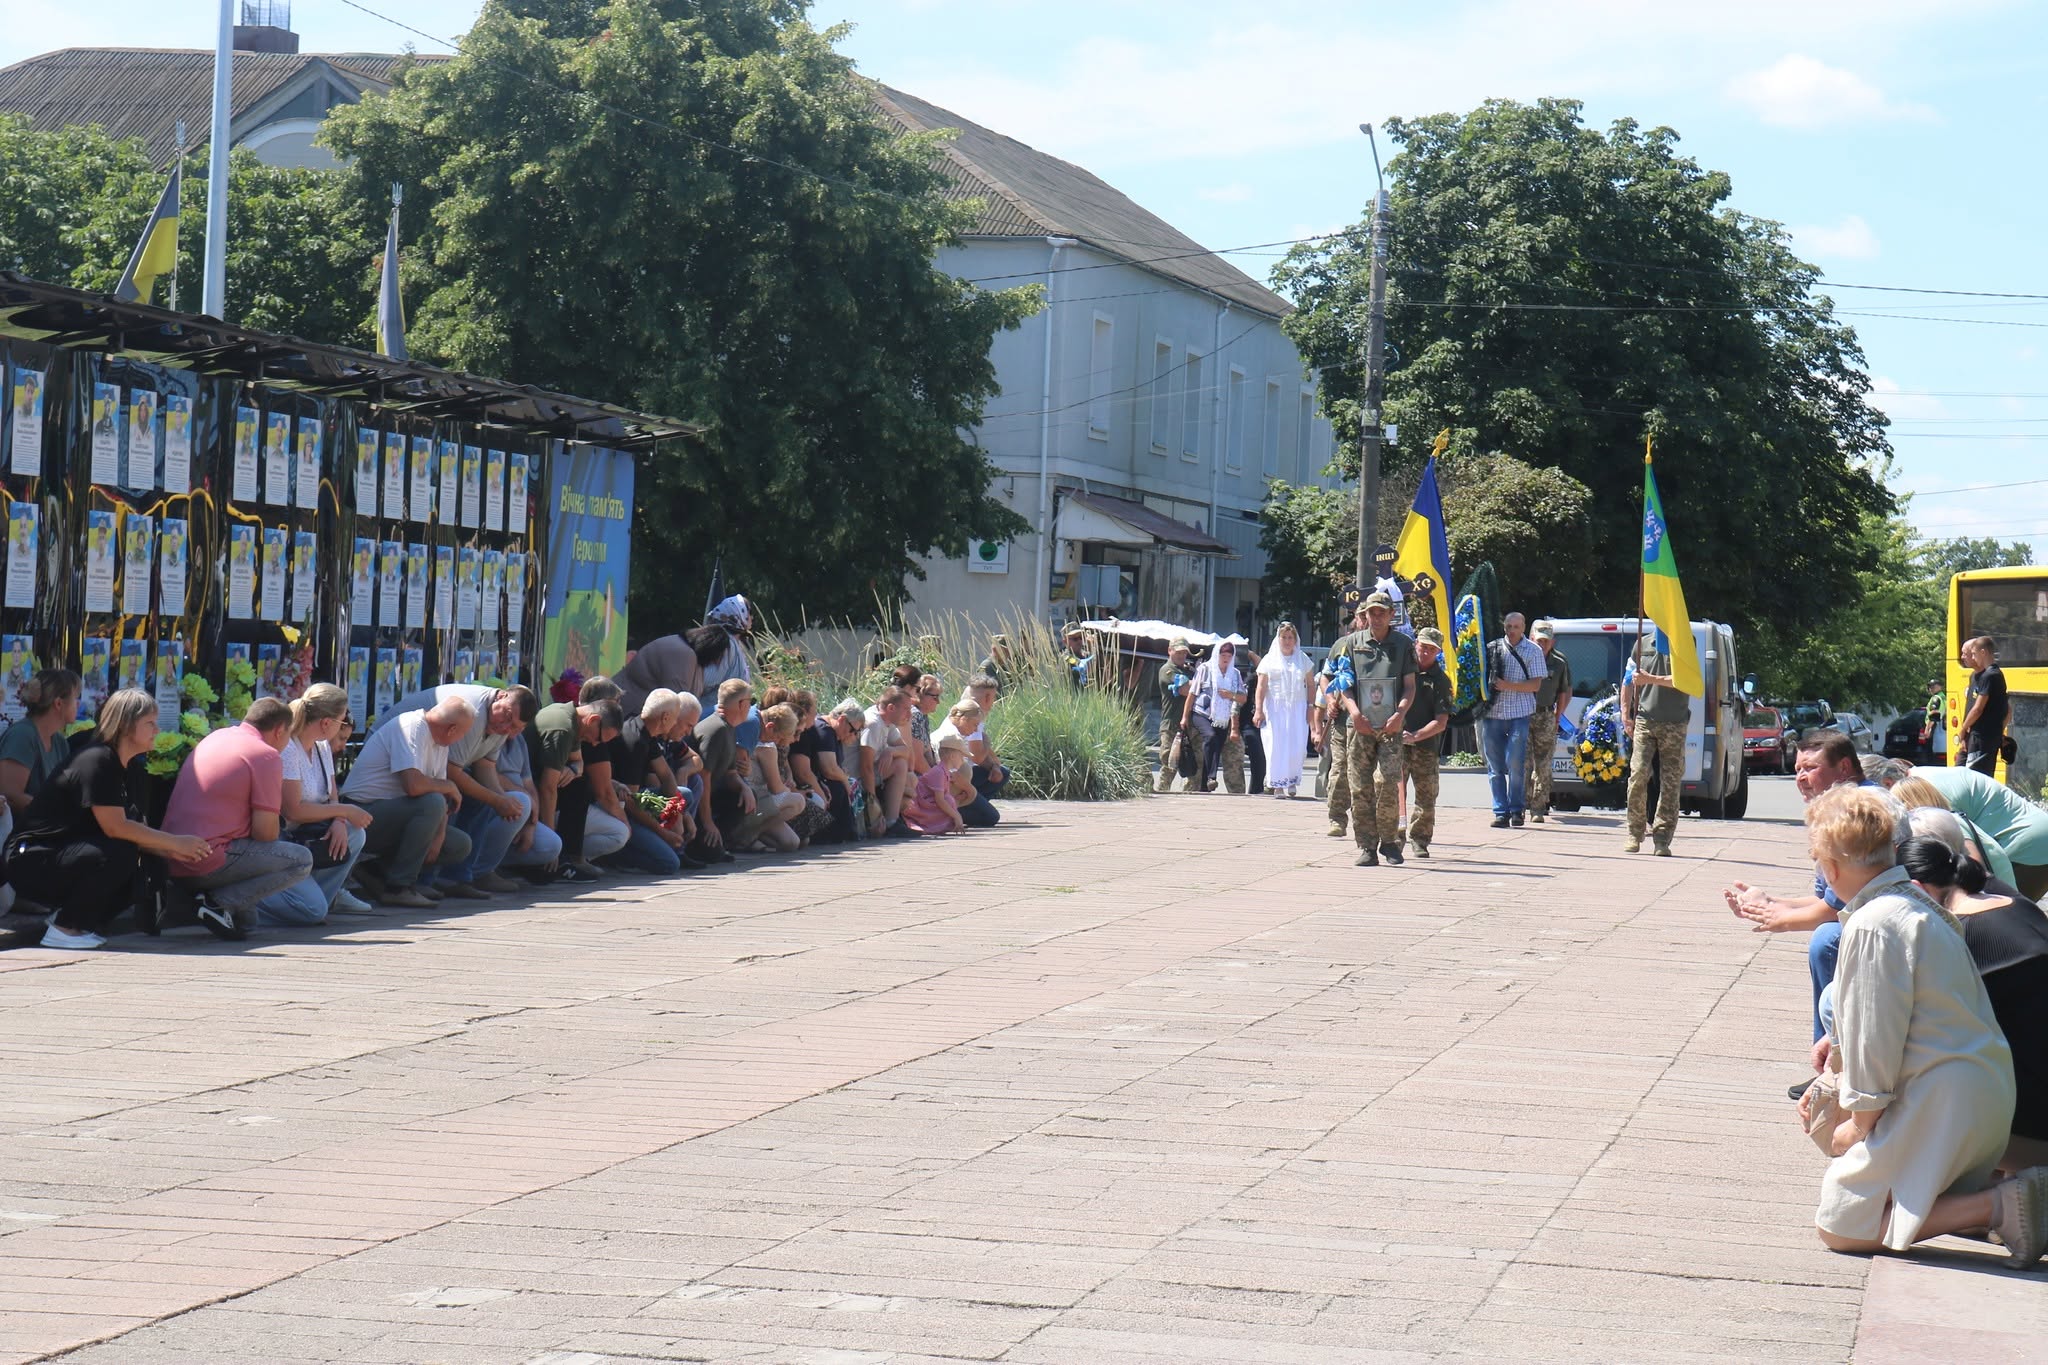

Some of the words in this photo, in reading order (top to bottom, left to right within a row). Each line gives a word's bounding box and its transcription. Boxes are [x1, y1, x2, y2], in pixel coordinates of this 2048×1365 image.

[560, 485, 585, 515] Вічна
[588, 491, 624, 520] пам'ять
[572, 533, 607, 567] Героям
